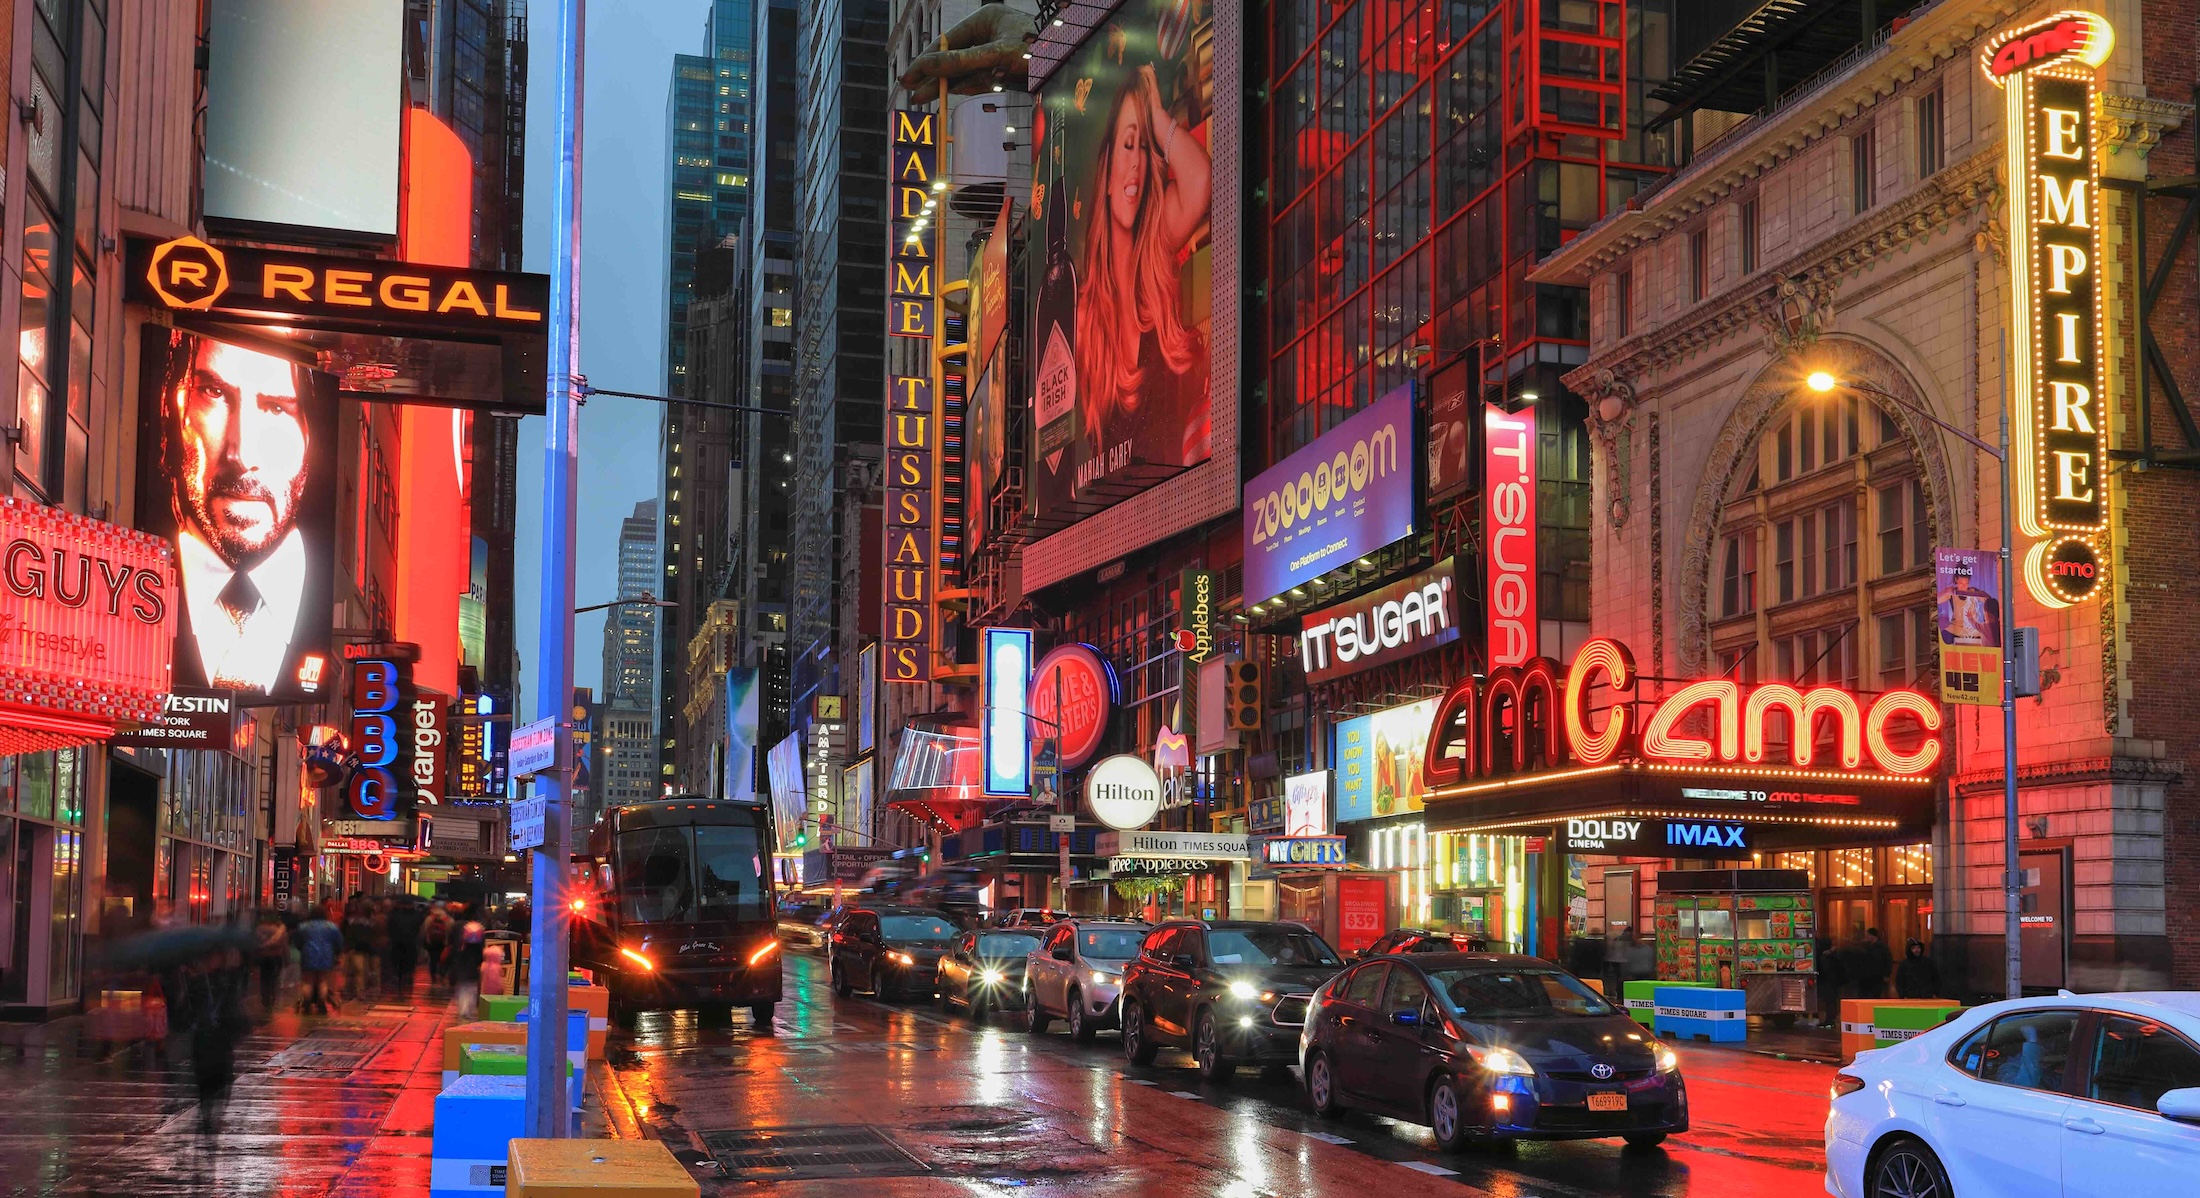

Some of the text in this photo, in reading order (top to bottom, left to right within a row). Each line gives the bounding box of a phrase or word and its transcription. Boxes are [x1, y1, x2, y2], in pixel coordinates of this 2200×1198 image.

[896, 112, 933, 334] MADAME
[171, 261, 208, 287] R
[263, 263, 541, 321] REGAL
[2039, 107, 2096, 502] EMPIRE
[1041, 366, 1069, 396] BLACK
[1043, 385, 1066, 412] IRISH
[1078, 438, 1132, 489] MARIAH CAREY
[892, 377, 925, 679] TUSSAUD'S
[1493, 420, 1530, 665] IT'SUGA
[1290, 537, 1348, 571] One Platform to Connect
[1940, 552, 1977, 564] Let's get
[4, 538, 166, 625] GUYS
[1940, 566, 1973, 576] started
[1189, 574, 1212, 664] Applebee's
[1301, 582, 1447, 674] IT'SUGAR
[18, 621, 106, 660] freestyle
[1945, 652, 1997, 673] NEW
[1080, 671, 1095, 697] &
[1946, 672, 1979, 692] 42
[1947, 693, 1980, 702] New42.org
[164, 717, 190, 726] YORK
[463, 698, 477, 756] VICTRY
[168, 730, 207, 739] SQUARE
[350, 660, 399, 820] BBQ
[413, 700, 441, 785] target
[1347, 730, 1360, 744] YOU
[1344, 745, 1363, 760] KNOW
[1347, 762, 1360, 776] YOU
[817, 724, 829, 837] AMSTERD
[1344, 778, 1363, 792] WANT
[1096, 783, 1154, 801] Hilton
[1350, 794, 1357, 808] IT
[1750, 791, 1767, 801] TO
[1134, 837, 1177, 850] Hilton
[1183, 841, 1214, 851] TIMES
[1568, 820, 1746, 848] DOLBY IMAX
[1568, 839, 1604, 849] CINEMA
[350, 840, 379, 850] BBQ
[1270, 841, 1344, 863] MY GIFTS
[1348, 914, 1375, 928] $39
[1660, 1007, 1707, 1018] TIMES SQUARE
[1881, 1030, 1903, 1039] TIMES
[1591, 1096, 1624, 1107] T669919C
